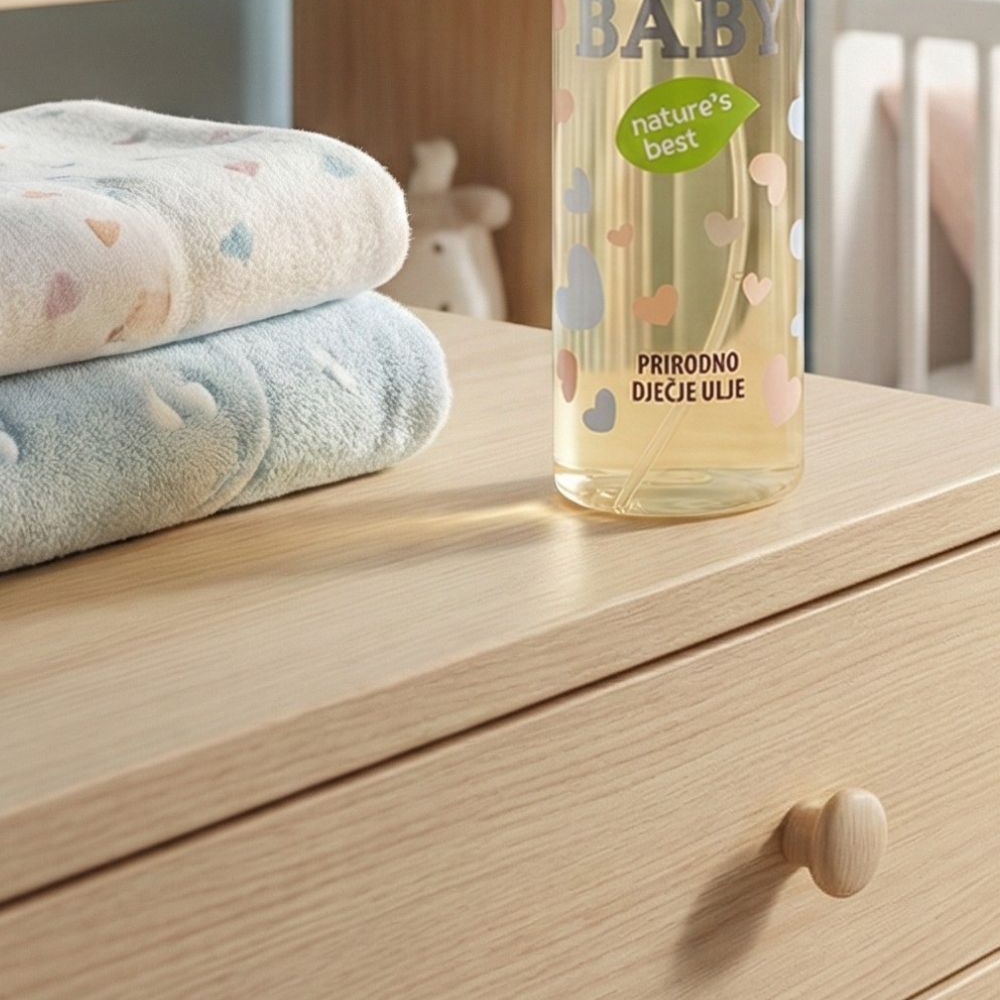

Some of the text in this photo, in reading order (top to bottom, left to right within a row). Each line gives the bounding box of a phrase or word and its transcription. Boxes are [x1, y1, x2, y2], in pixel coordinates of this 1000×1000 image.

[631, 92, 733, 136] nature's
[643, 130, 699, 161] best
[637, 352, 739, 375] PRIRODNO
[632, 377, 745, 402] DJEČJE ULJE
